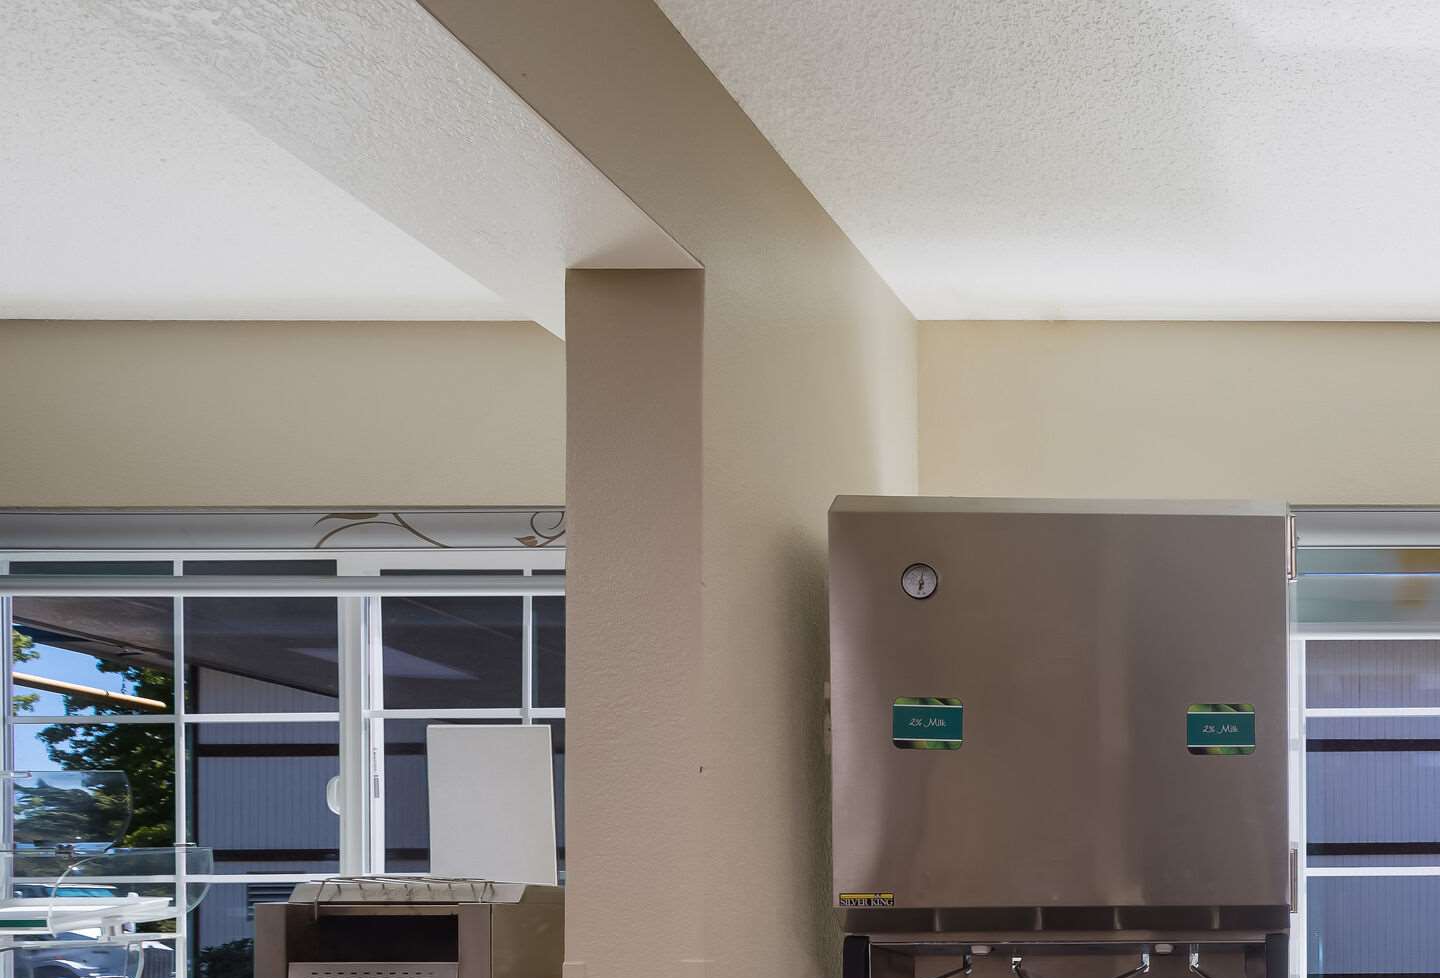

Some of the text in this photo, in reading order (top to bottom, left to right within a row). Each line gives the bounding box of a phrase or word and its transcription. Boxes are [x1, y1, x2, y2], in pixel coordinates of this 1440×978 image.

[923, 717, 946, 728] Milk
[1217, 723, 1240, 735] Milk
[840, 897, 894, 907] SILVER KING
